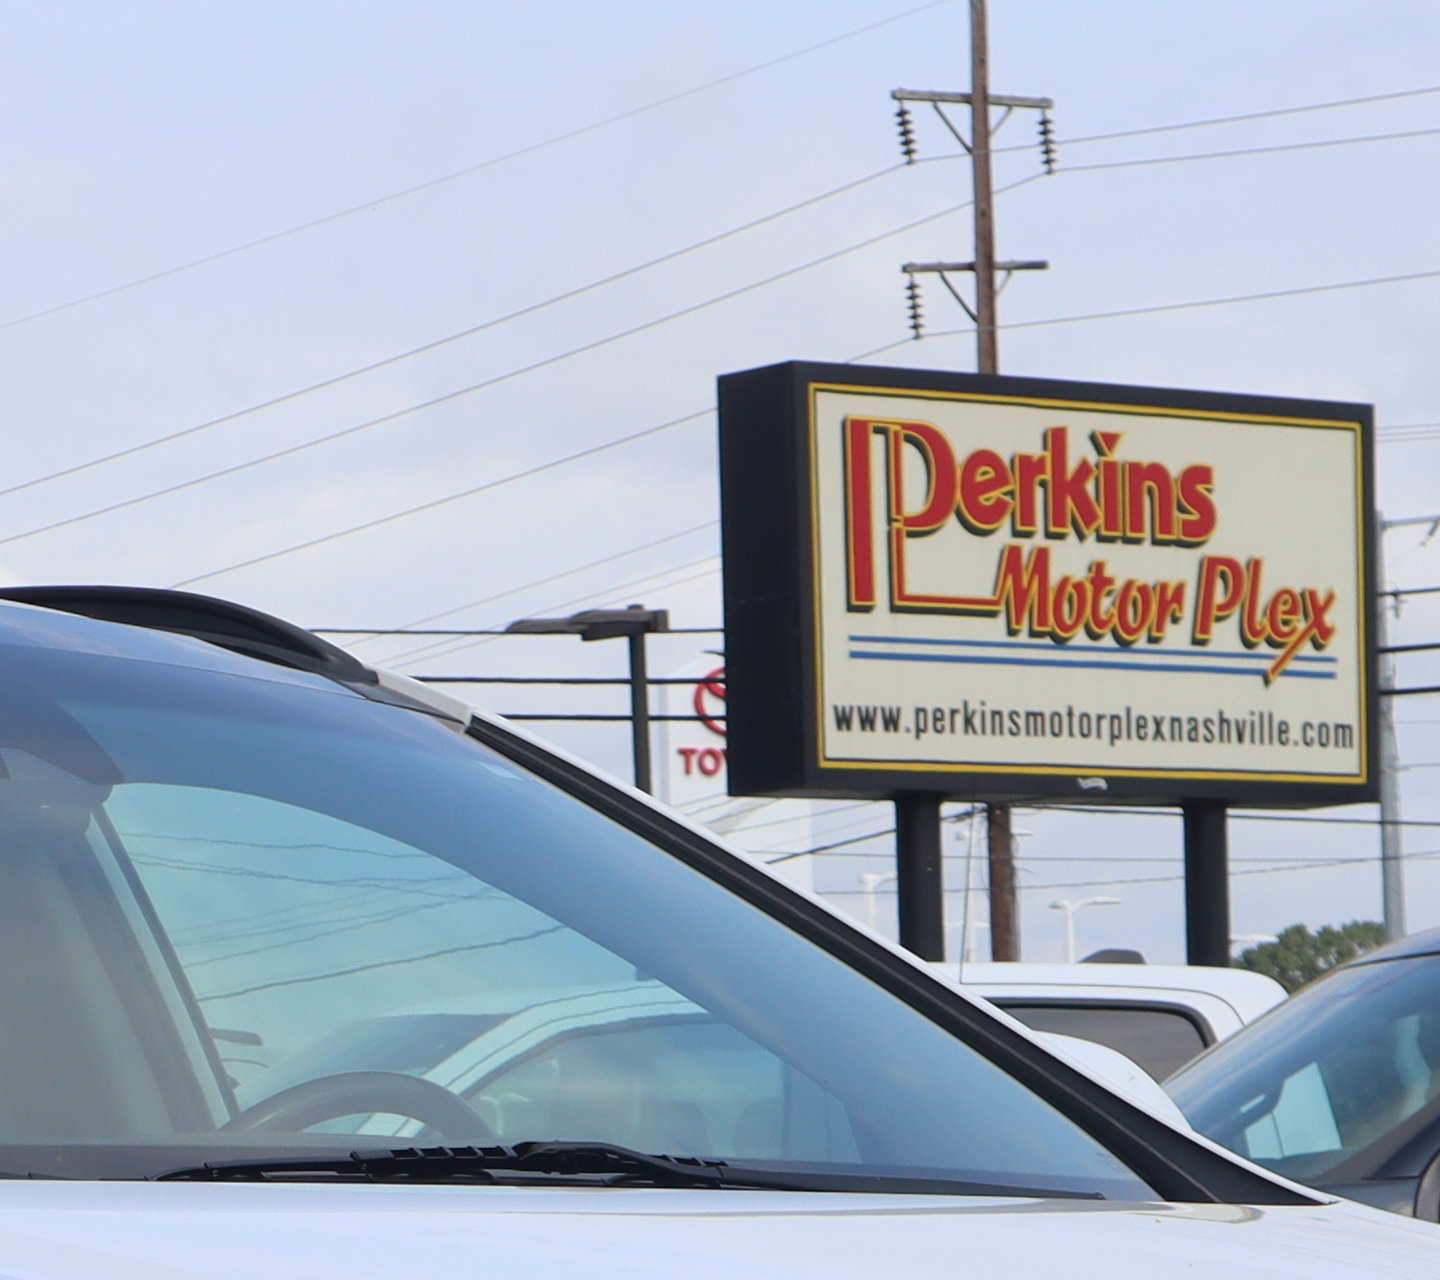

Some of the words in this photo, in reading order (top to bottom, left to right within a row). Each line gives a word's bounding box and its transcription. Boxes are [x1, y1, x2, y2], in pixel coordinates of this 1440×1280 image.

[843, 415, 1218, 612] Perkins
[997, 543, 1186, 646] Motor
[1193, 554, 1338, 687] Plex
[832, 700, 1355, 749] www.perkinsmotorplexnashville.com
